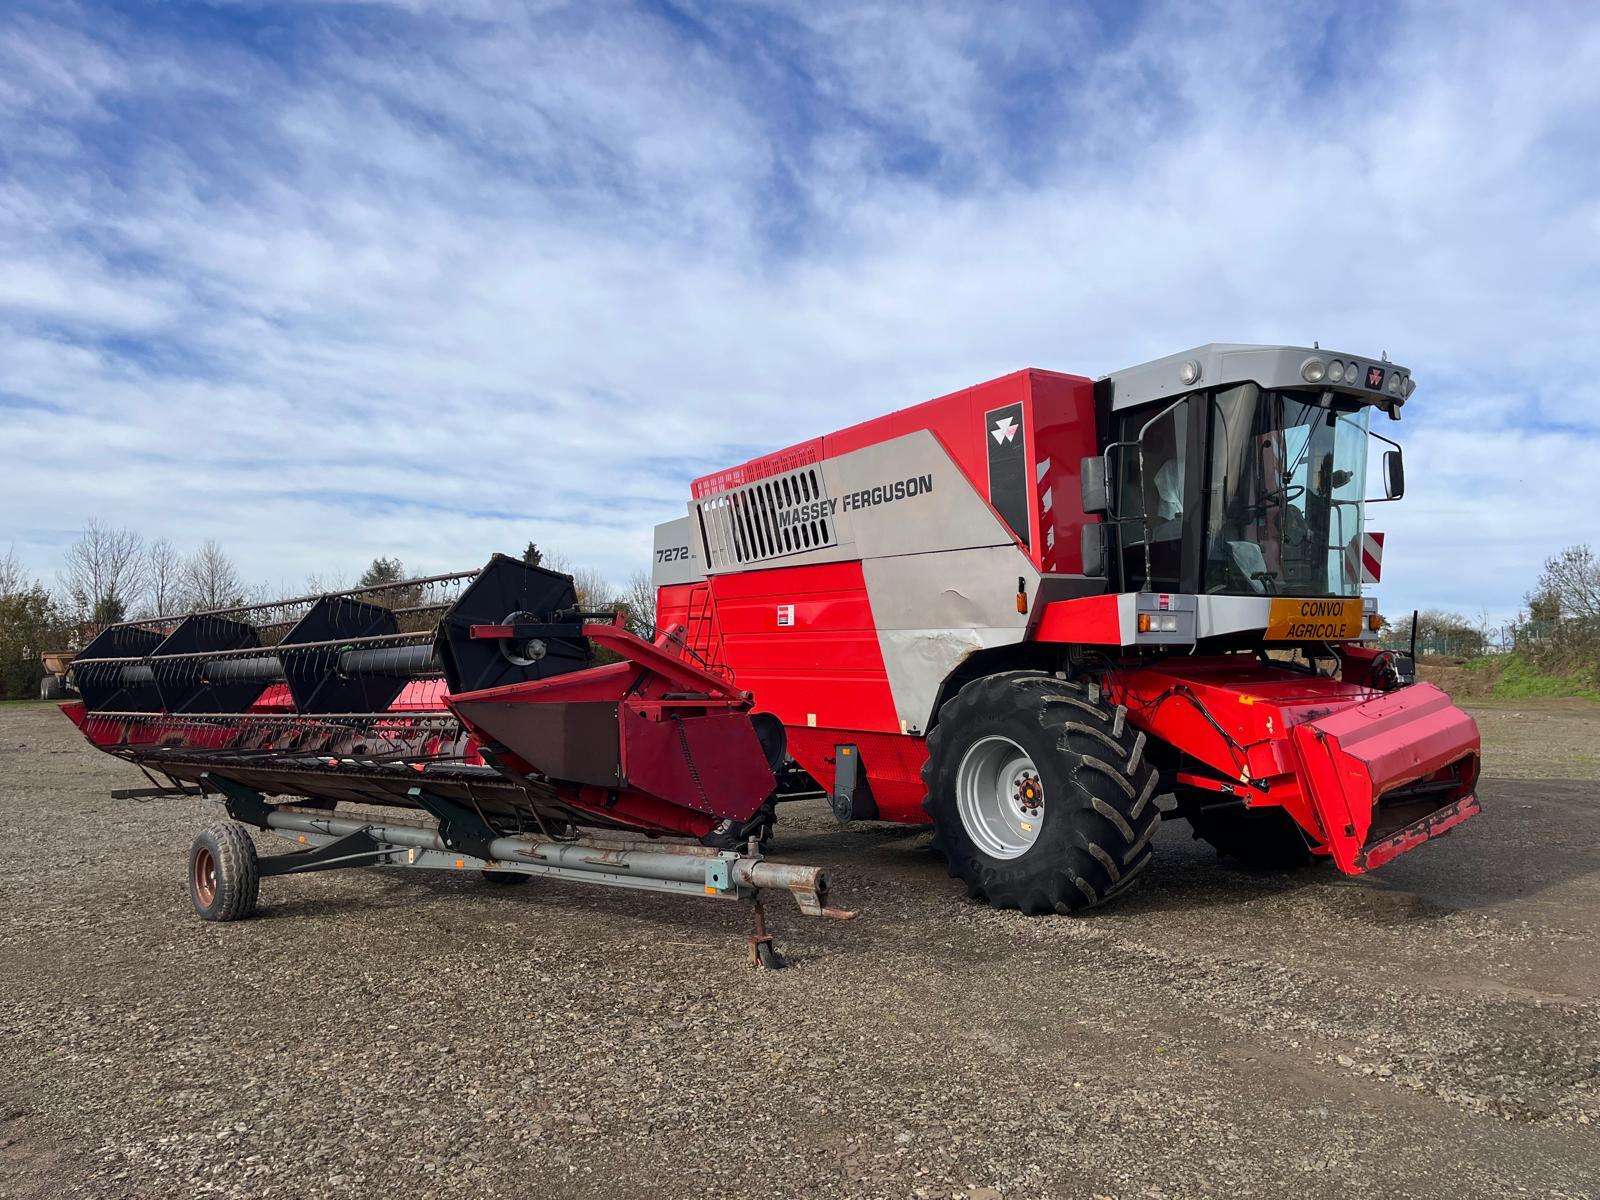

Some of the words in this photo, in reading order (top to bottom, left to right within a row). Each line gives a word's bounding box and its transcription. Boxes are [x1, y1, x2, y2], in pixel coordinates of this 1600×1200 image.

[778, 498, 837, 527] MASSEY
[843, 474, 933, 512] FERGUSON
[656, 546, 689, 563] 7272
[1301, 602, 1344, 617] CONVOI
[1286, 623, 1347, 638] AGRICOLE
